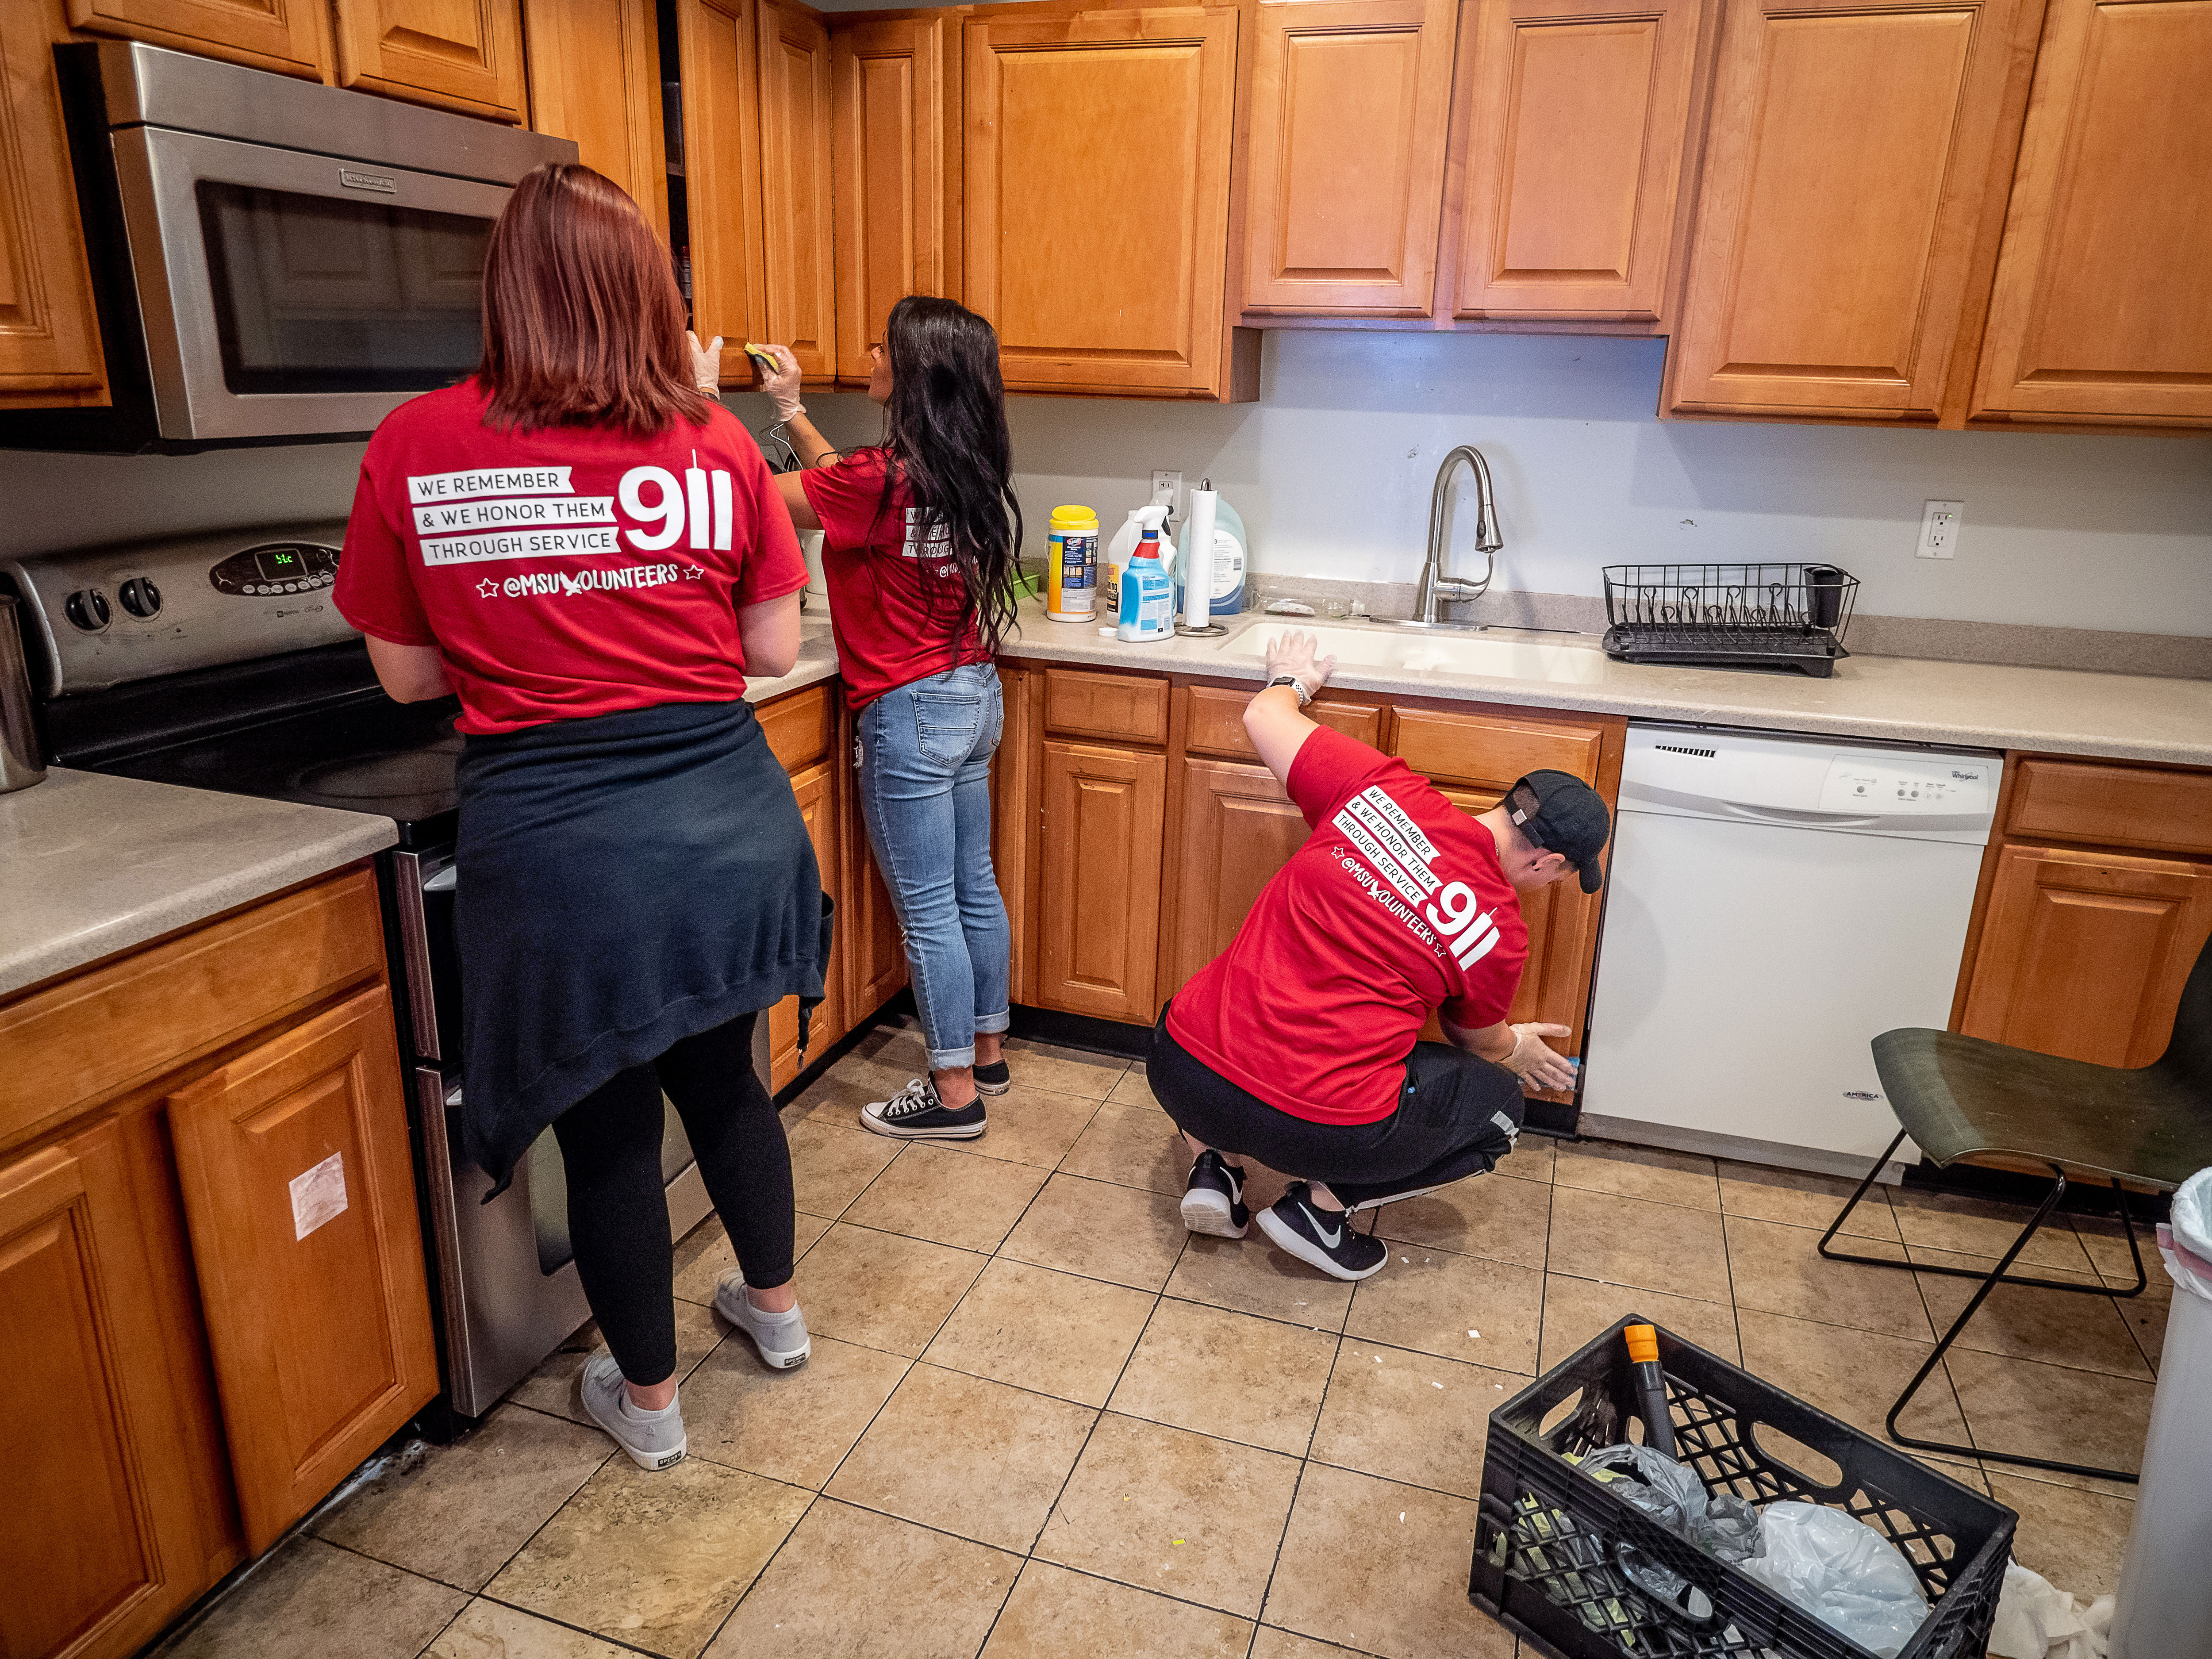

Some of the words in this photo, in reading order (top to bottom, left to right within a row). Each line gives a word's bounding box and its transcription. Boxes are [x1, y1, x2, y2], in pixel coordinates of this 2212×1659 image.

[418, 480, 447, 496] WE
[453, 473, 559, 492] REMEMBER
[423, 513, 434, 527] &
[441, 509, 472, 525] WE
[477, 504, 546, 522] HONOR
[553, 503, 605, 518] THEM
[618, 449, 733, 550] 911
[429, 537, 522, 559] THROUGH
[530, 533, 611, 551] SERVICE
[1338, 814, 1380, 858] THROUGH
[1378, 857, 1421, 901] SERVICE
[1352, 801, 1361, 810] &
[1360, 807, 1377, 824] WE
[1374, 822, 1407, 858] HONOR
[1408, 857, 1435, 887] THEM
[1369, 789, 1386, 804] WE
[1383, 803, 1430, 855] REMEMBER
[1426, 881, 1500, 972] 911
